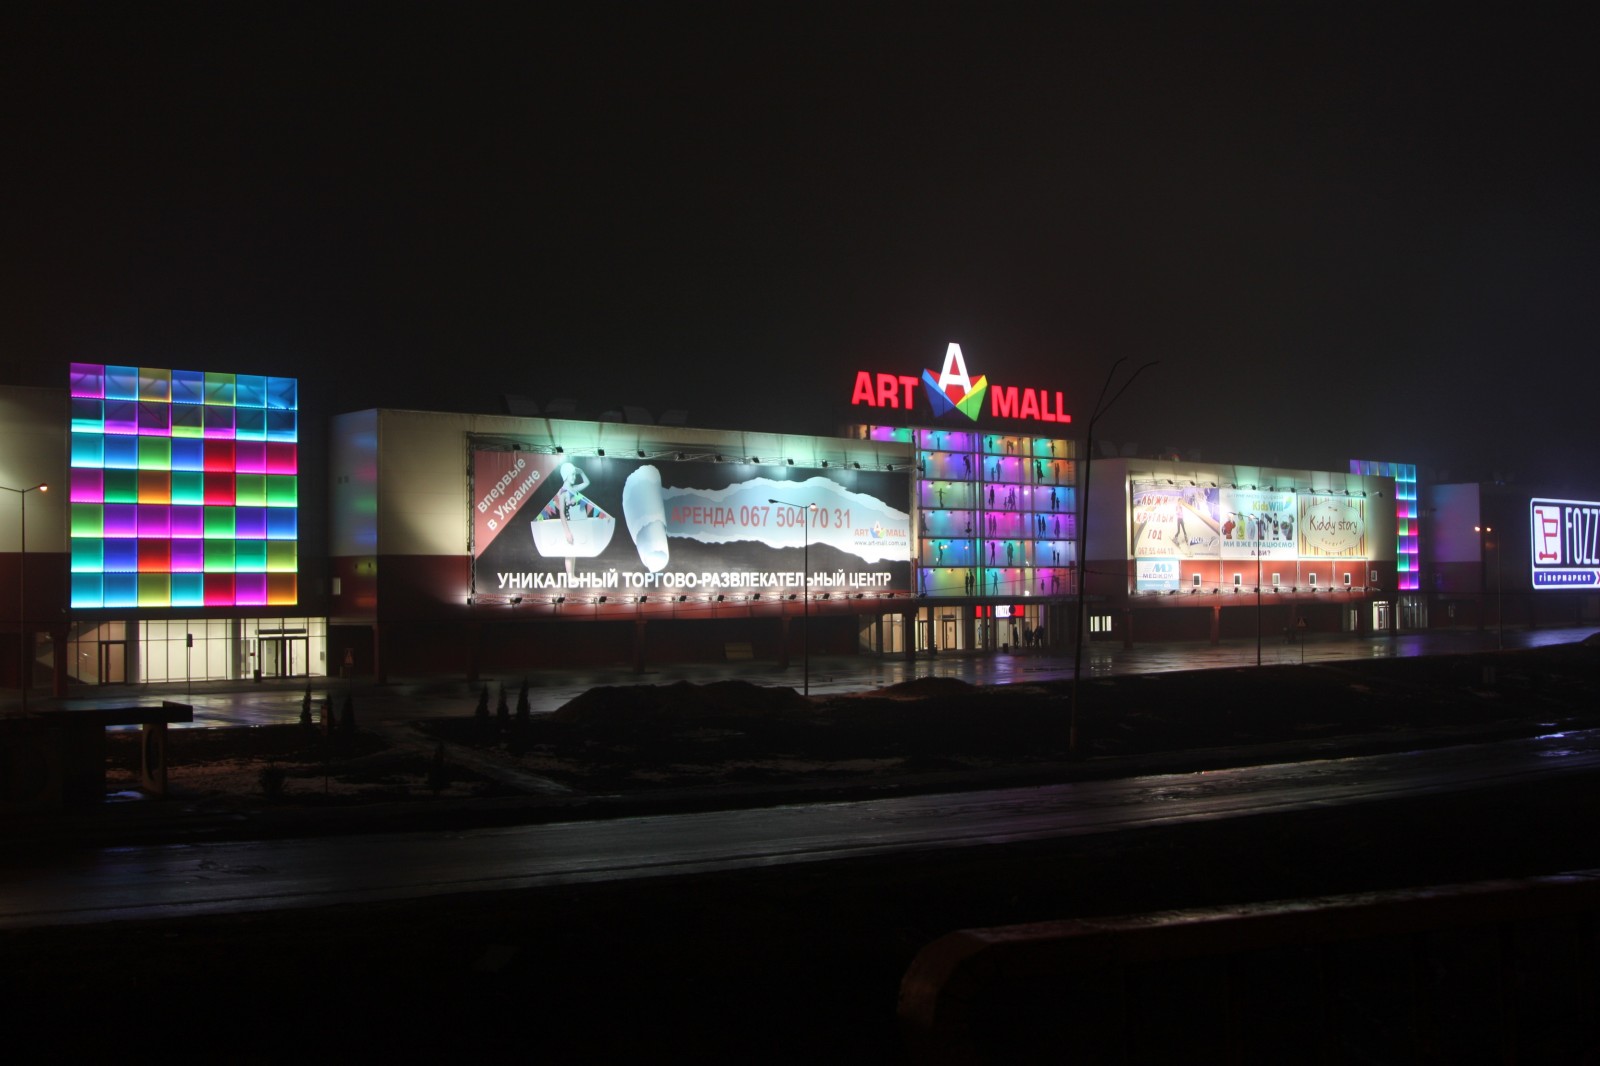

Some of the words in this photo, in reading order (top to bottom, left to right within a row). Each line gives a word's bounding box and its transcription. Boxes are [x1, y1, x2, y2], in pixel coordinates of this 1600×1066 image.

[851, 371, 919, 409] ART
[938, 342, 973, 395] A
[991, 385, 1072, 423] MALL
[477, 458, 526, 513] впервые
[487, 518, 498, 530] в
[494, 470, 540, 520] Украине
[671, 506, 735, 527] АРЕНДА
[740, 505, 769, 527] 067
[776, 506, 805, 528] 504
[810, 507, 829, 528] 70
[834, 508, 851, 529] 31
[854, 528, 869, 536] ART
[886, 529, 907, 537] MALL
[1309, 515, 1336, 535] Kiddy
[1338, 517, 1358, 535] story
[1565, 506, 1600, 565] FOZZ
[497, 568, 618, 589] УНИКАЛЬНЫЙ
[849, 572, 892, 589] ЦЕНТР
